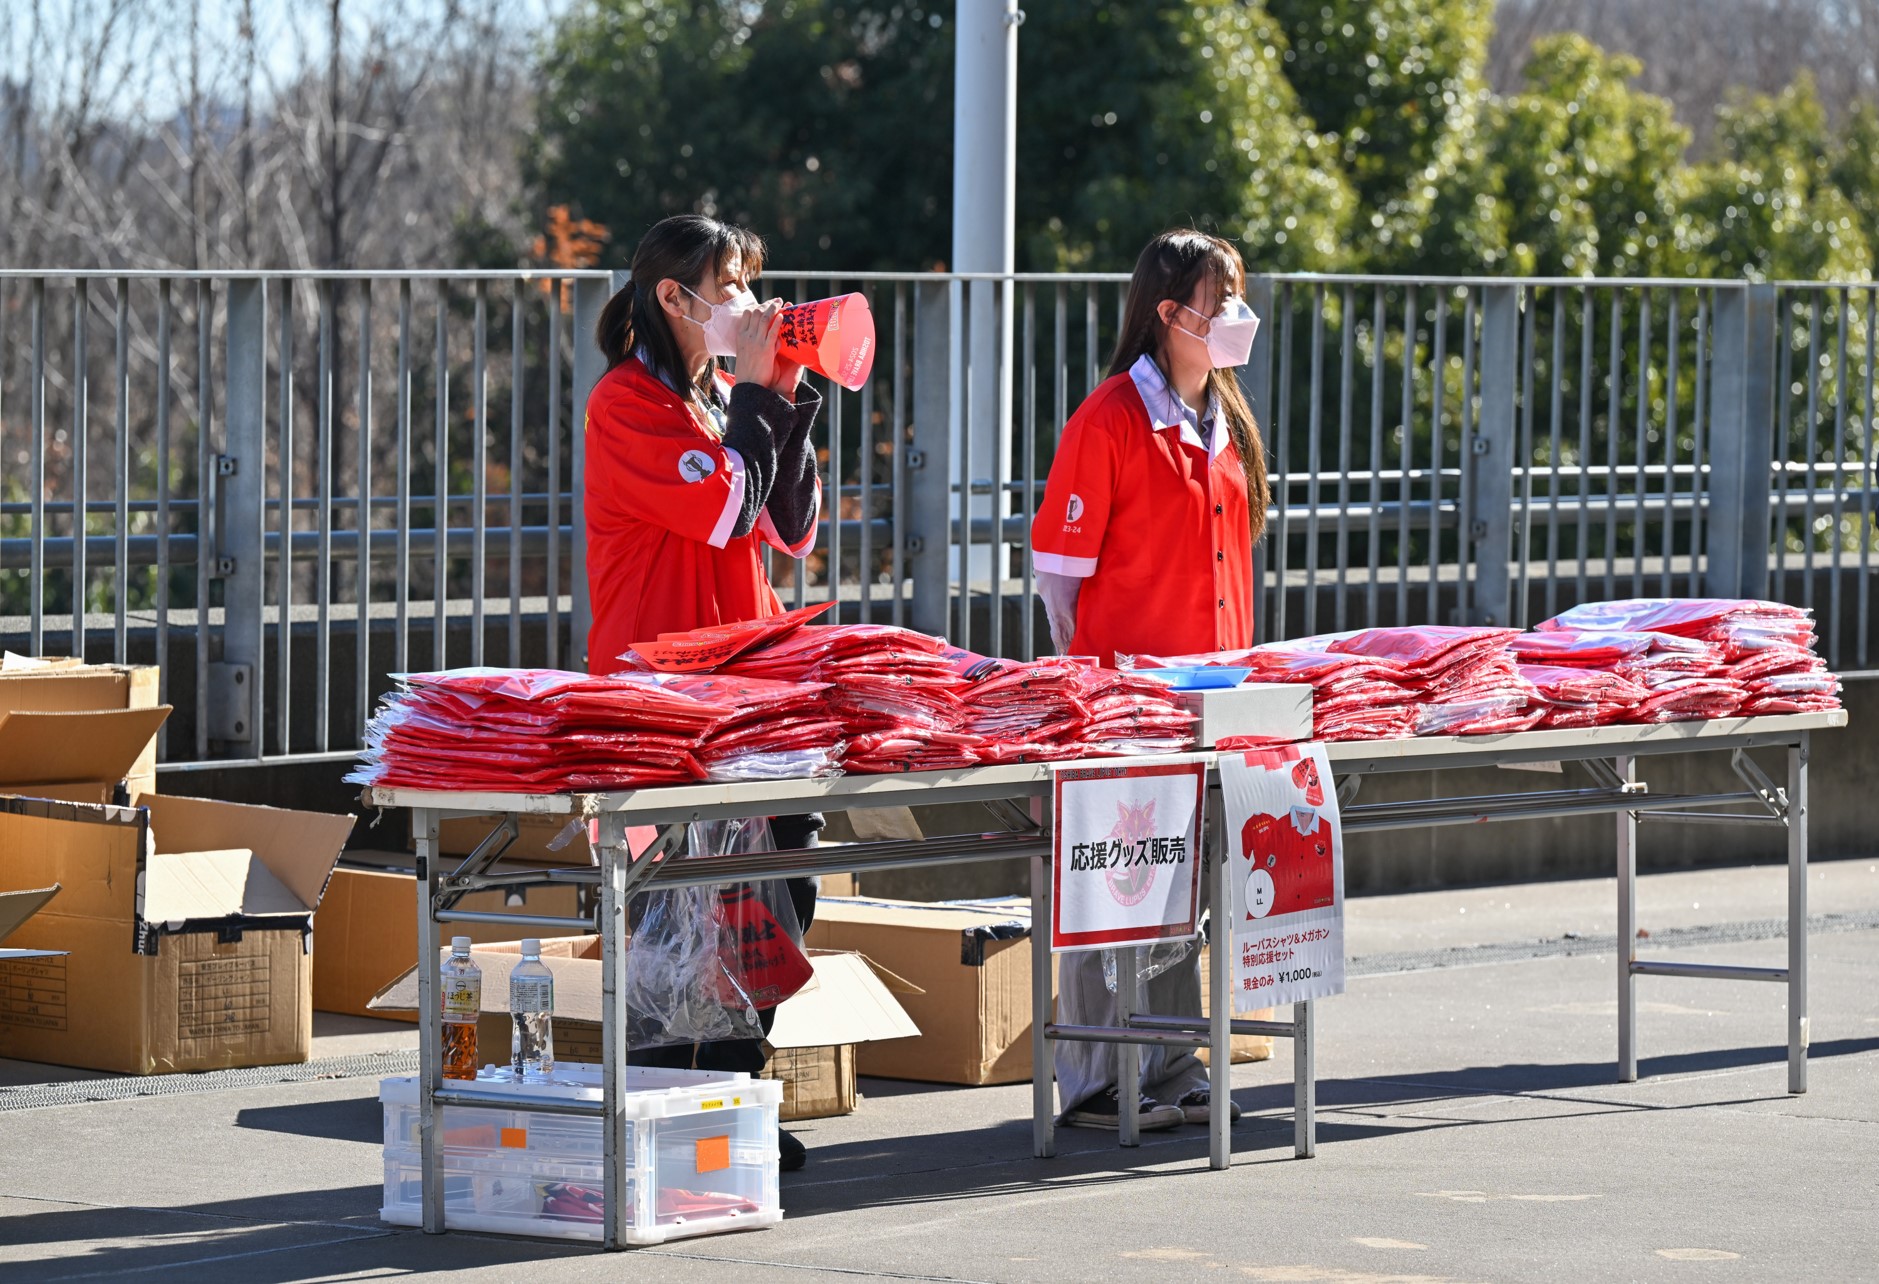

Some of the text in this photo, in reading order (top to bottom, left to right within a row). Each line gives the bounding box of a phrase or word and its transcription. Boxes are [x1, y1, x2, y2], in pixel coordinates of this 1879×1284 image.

[1070, 836, 1186, 871] 応援グッズ販売
[1108, 879, 1146, 906] BRAVE LUPUS
[1243, 948, 1294, 968] 特別応援セット
[1244, 975, 1274, 990] 現金のみ
[447, 992, 473, 1001] ほうじ茶
